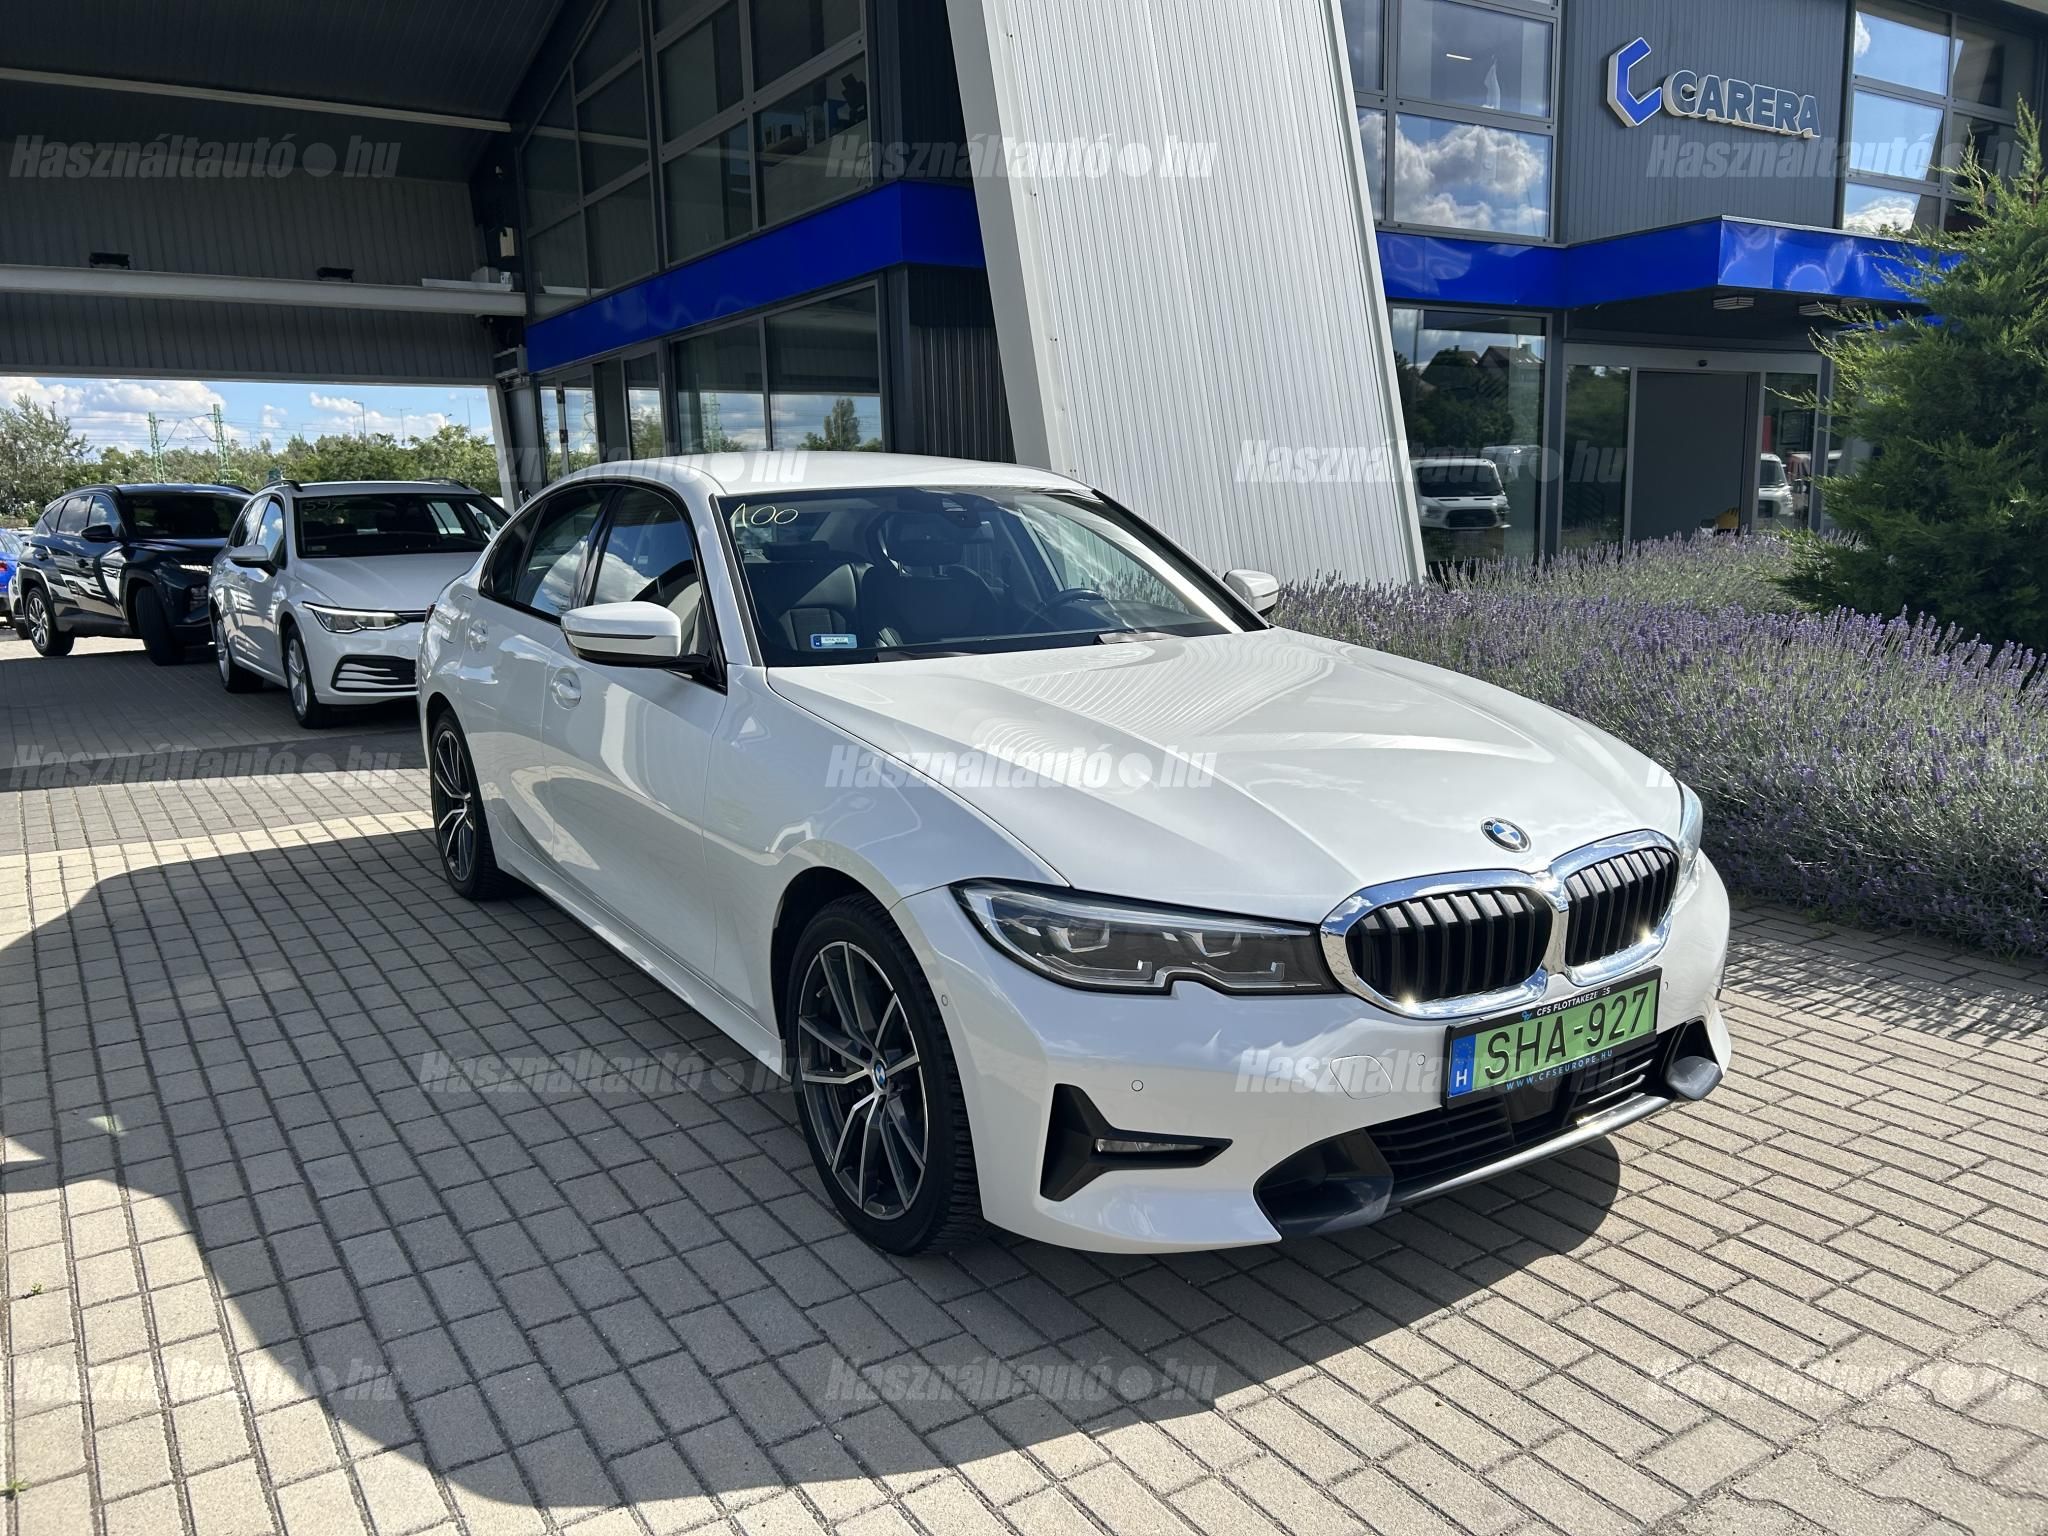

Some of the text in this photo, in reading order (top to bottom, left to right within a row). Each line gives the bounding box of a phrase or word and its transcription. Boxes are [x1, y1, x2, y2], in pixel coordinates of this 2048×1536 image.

[1663, 69, 1821, 139] CARERA
[729, 503, 799, 528] 100
[1536, 1005, 1552, 1017] CFS
[1484, 986, 1649, 1080] SHA-927
[1455, 1068, 1468, 1088] H
[1506, 1049, 1613, 1091] WWW.CFSEUROPE.HU
